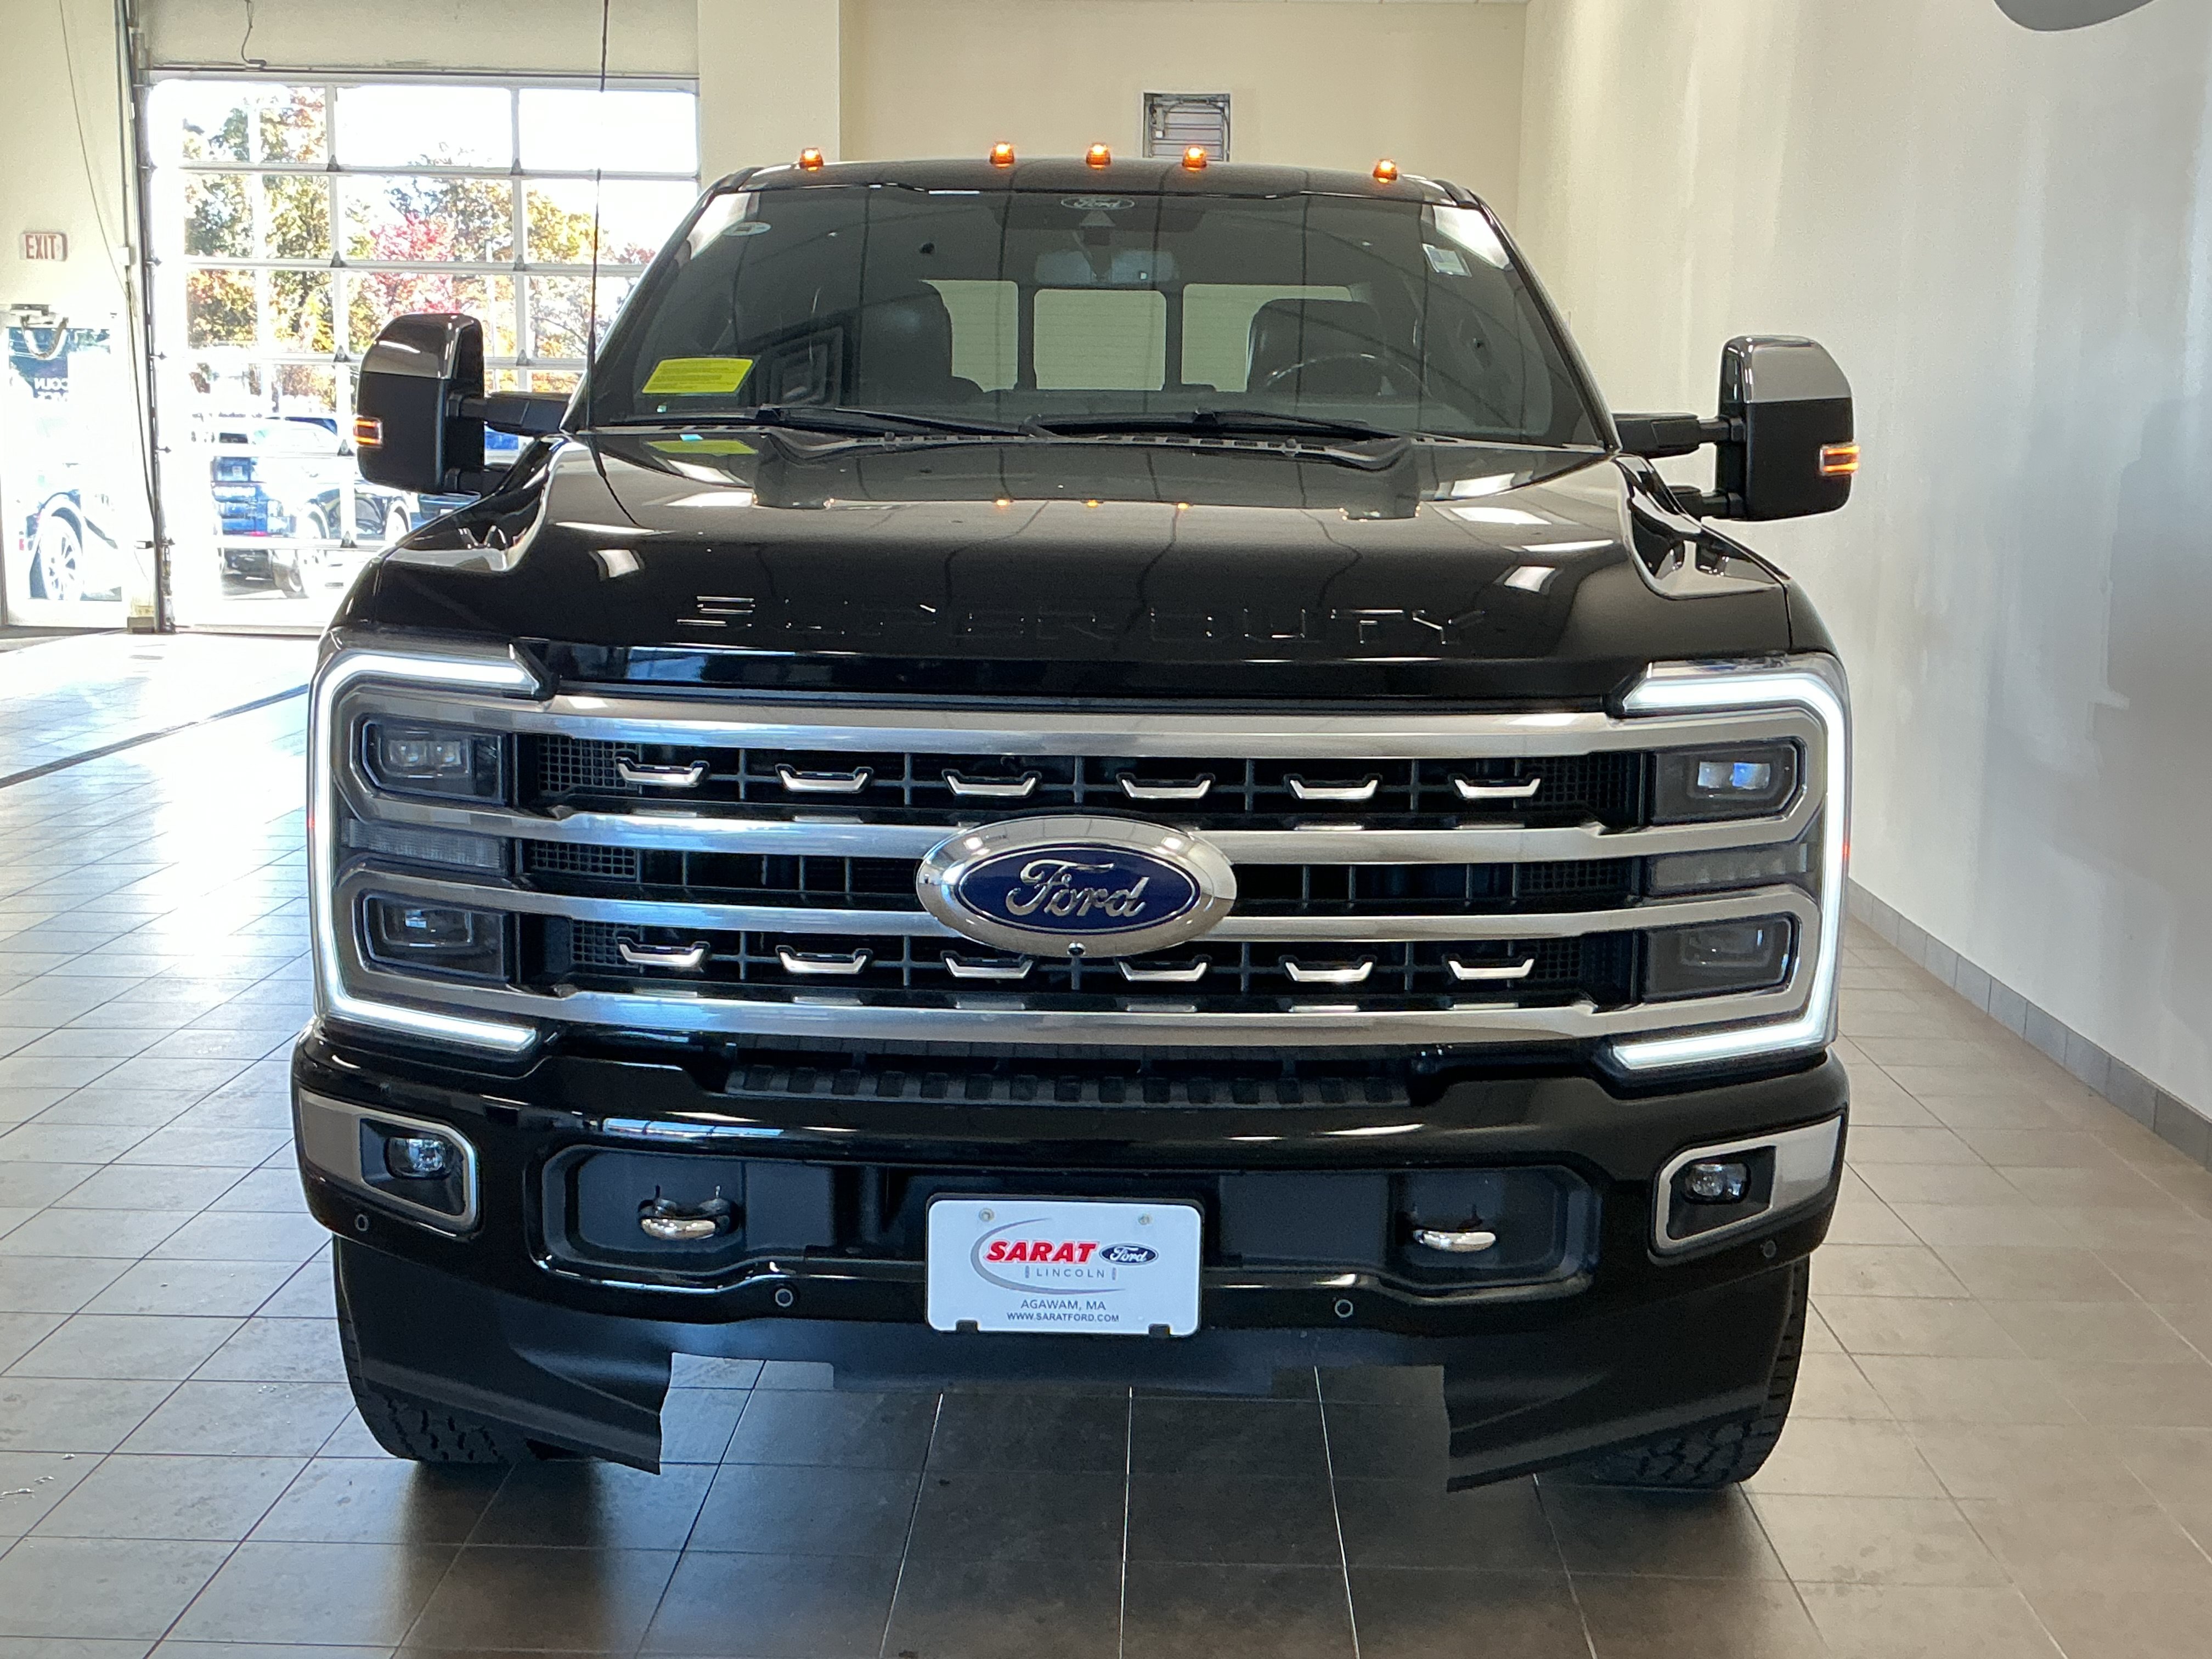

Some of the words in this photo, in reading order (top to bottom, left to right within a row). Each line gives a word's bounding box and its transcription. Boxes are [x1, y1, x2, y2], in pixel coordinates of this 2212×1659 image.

[1073, 197, 1121, 208] Ford
[25, 234, 57, 259] EXIT
[1150, 608, 1486, 644] DUTY
[1005, 859, 1150, 918] Ford
[986, 1240, 1098, 1263] SARAT
[1109, 1246, 1148, 1262] Ford
[1036, 1268, 1105, 1278] LINCOLN
[1020, 1299, 1082, 1311] AGAWAM,
[1086, 1301, 1107, 1311] MA
[1007, 1312, 1119, 1323] WWW.SARATFORD.COM
